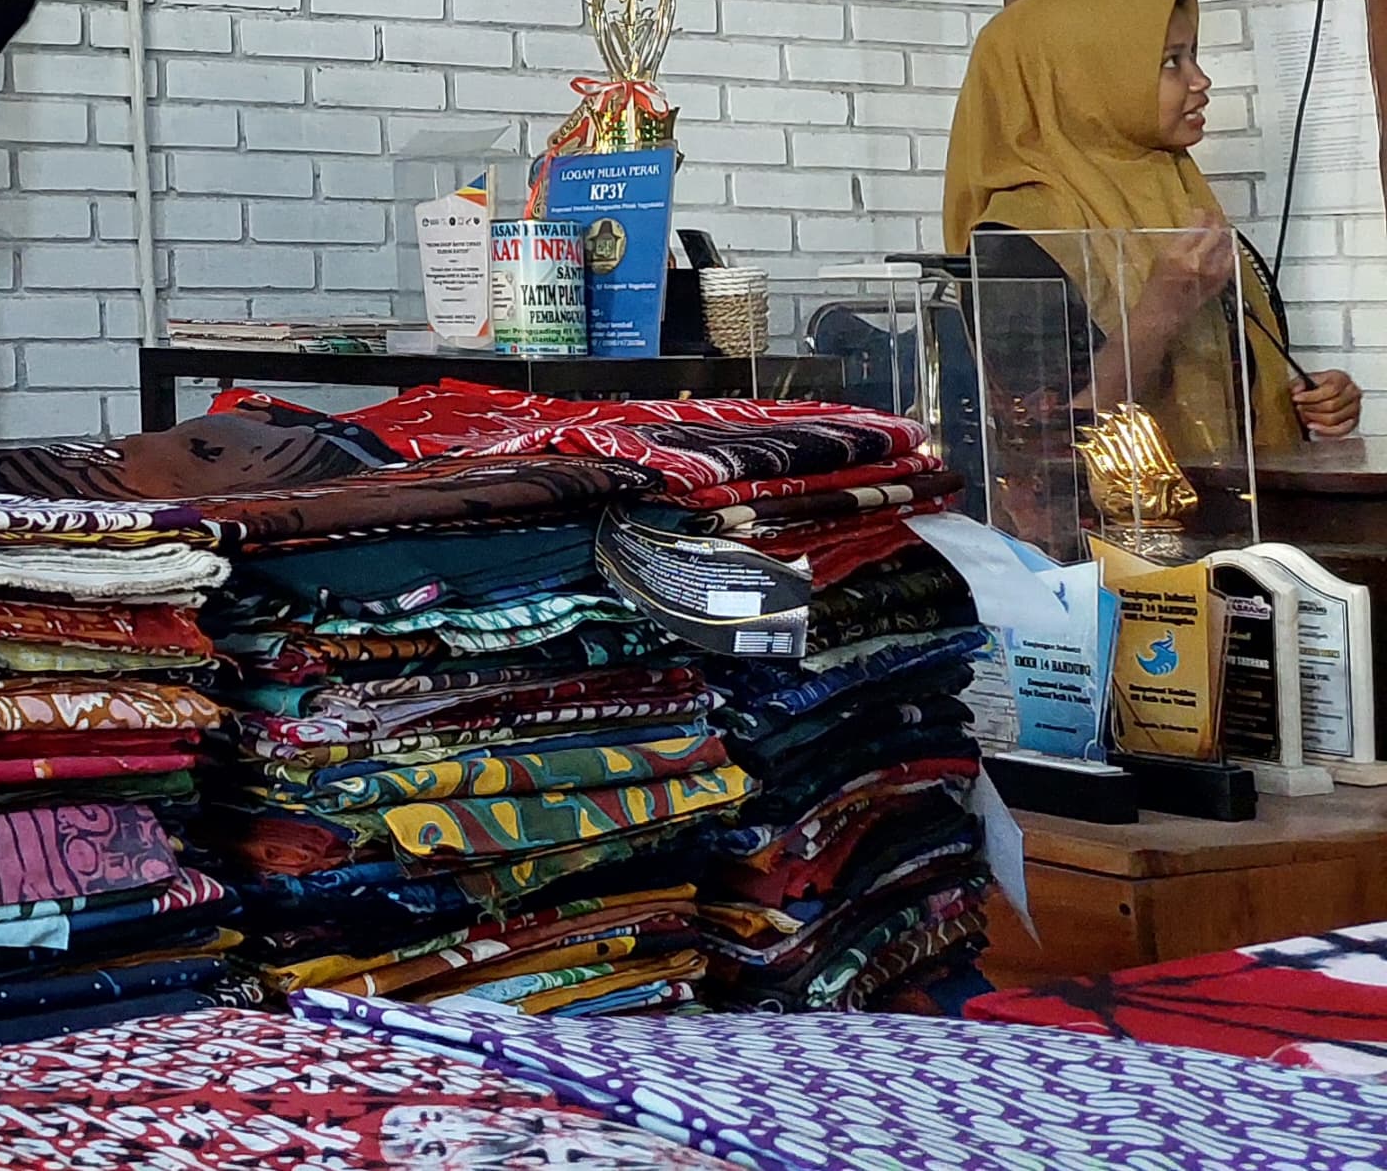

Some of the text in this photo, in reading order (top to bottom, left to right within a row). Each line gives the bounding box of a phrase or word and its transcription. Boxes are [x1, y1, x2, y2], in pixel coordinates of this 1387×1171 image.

[561, 164, 660, 181] LOGAM MULIA PERAK
[590, 182, 627, 201] KP3Y
[520, 285, 556, 306] YATIM
[1040, 658, 1050, 670] 14
[1051, 660, 1091, 676] BANDUNG
